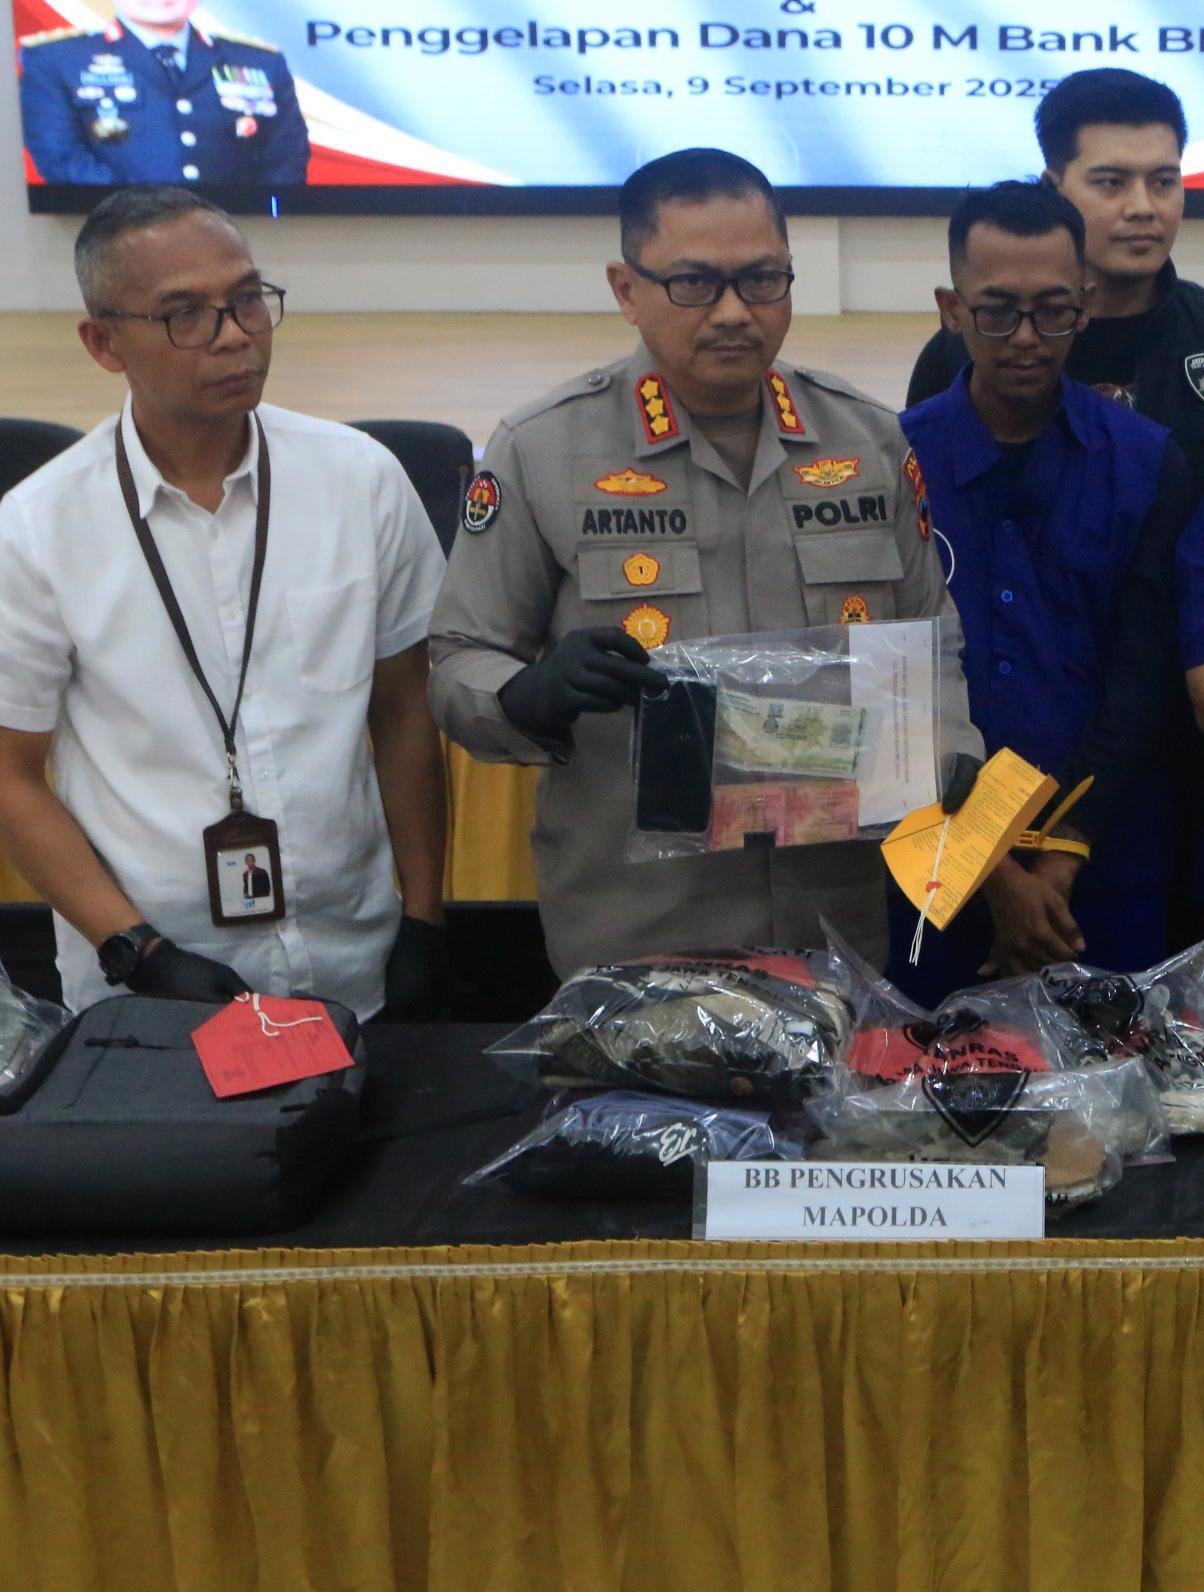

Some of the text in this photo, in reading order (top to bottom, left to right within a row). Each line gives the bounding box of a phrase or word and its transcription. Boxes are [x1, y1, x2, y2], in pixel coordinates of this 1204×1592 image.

[306, 20, 680, 55] Penggelapan
[700, 22, 843, 50] Dana
[857, 23, 914, 50] 10
[933, 24, 978, 51] M
[998, 25, 1140, 53] Bank
[533, 75, 673, 99] Selasa,
[687, 76, 710, 96] 9
[724, 76, 952, 100] September
[582, 507, 687, 535] ARTANTO
[792, 494, 887, 530] POLRI
[745, 1167, 1007, 1190] BB PENGRUSAKAN
[802, 1205, 948, 1227] MAPOLDA
